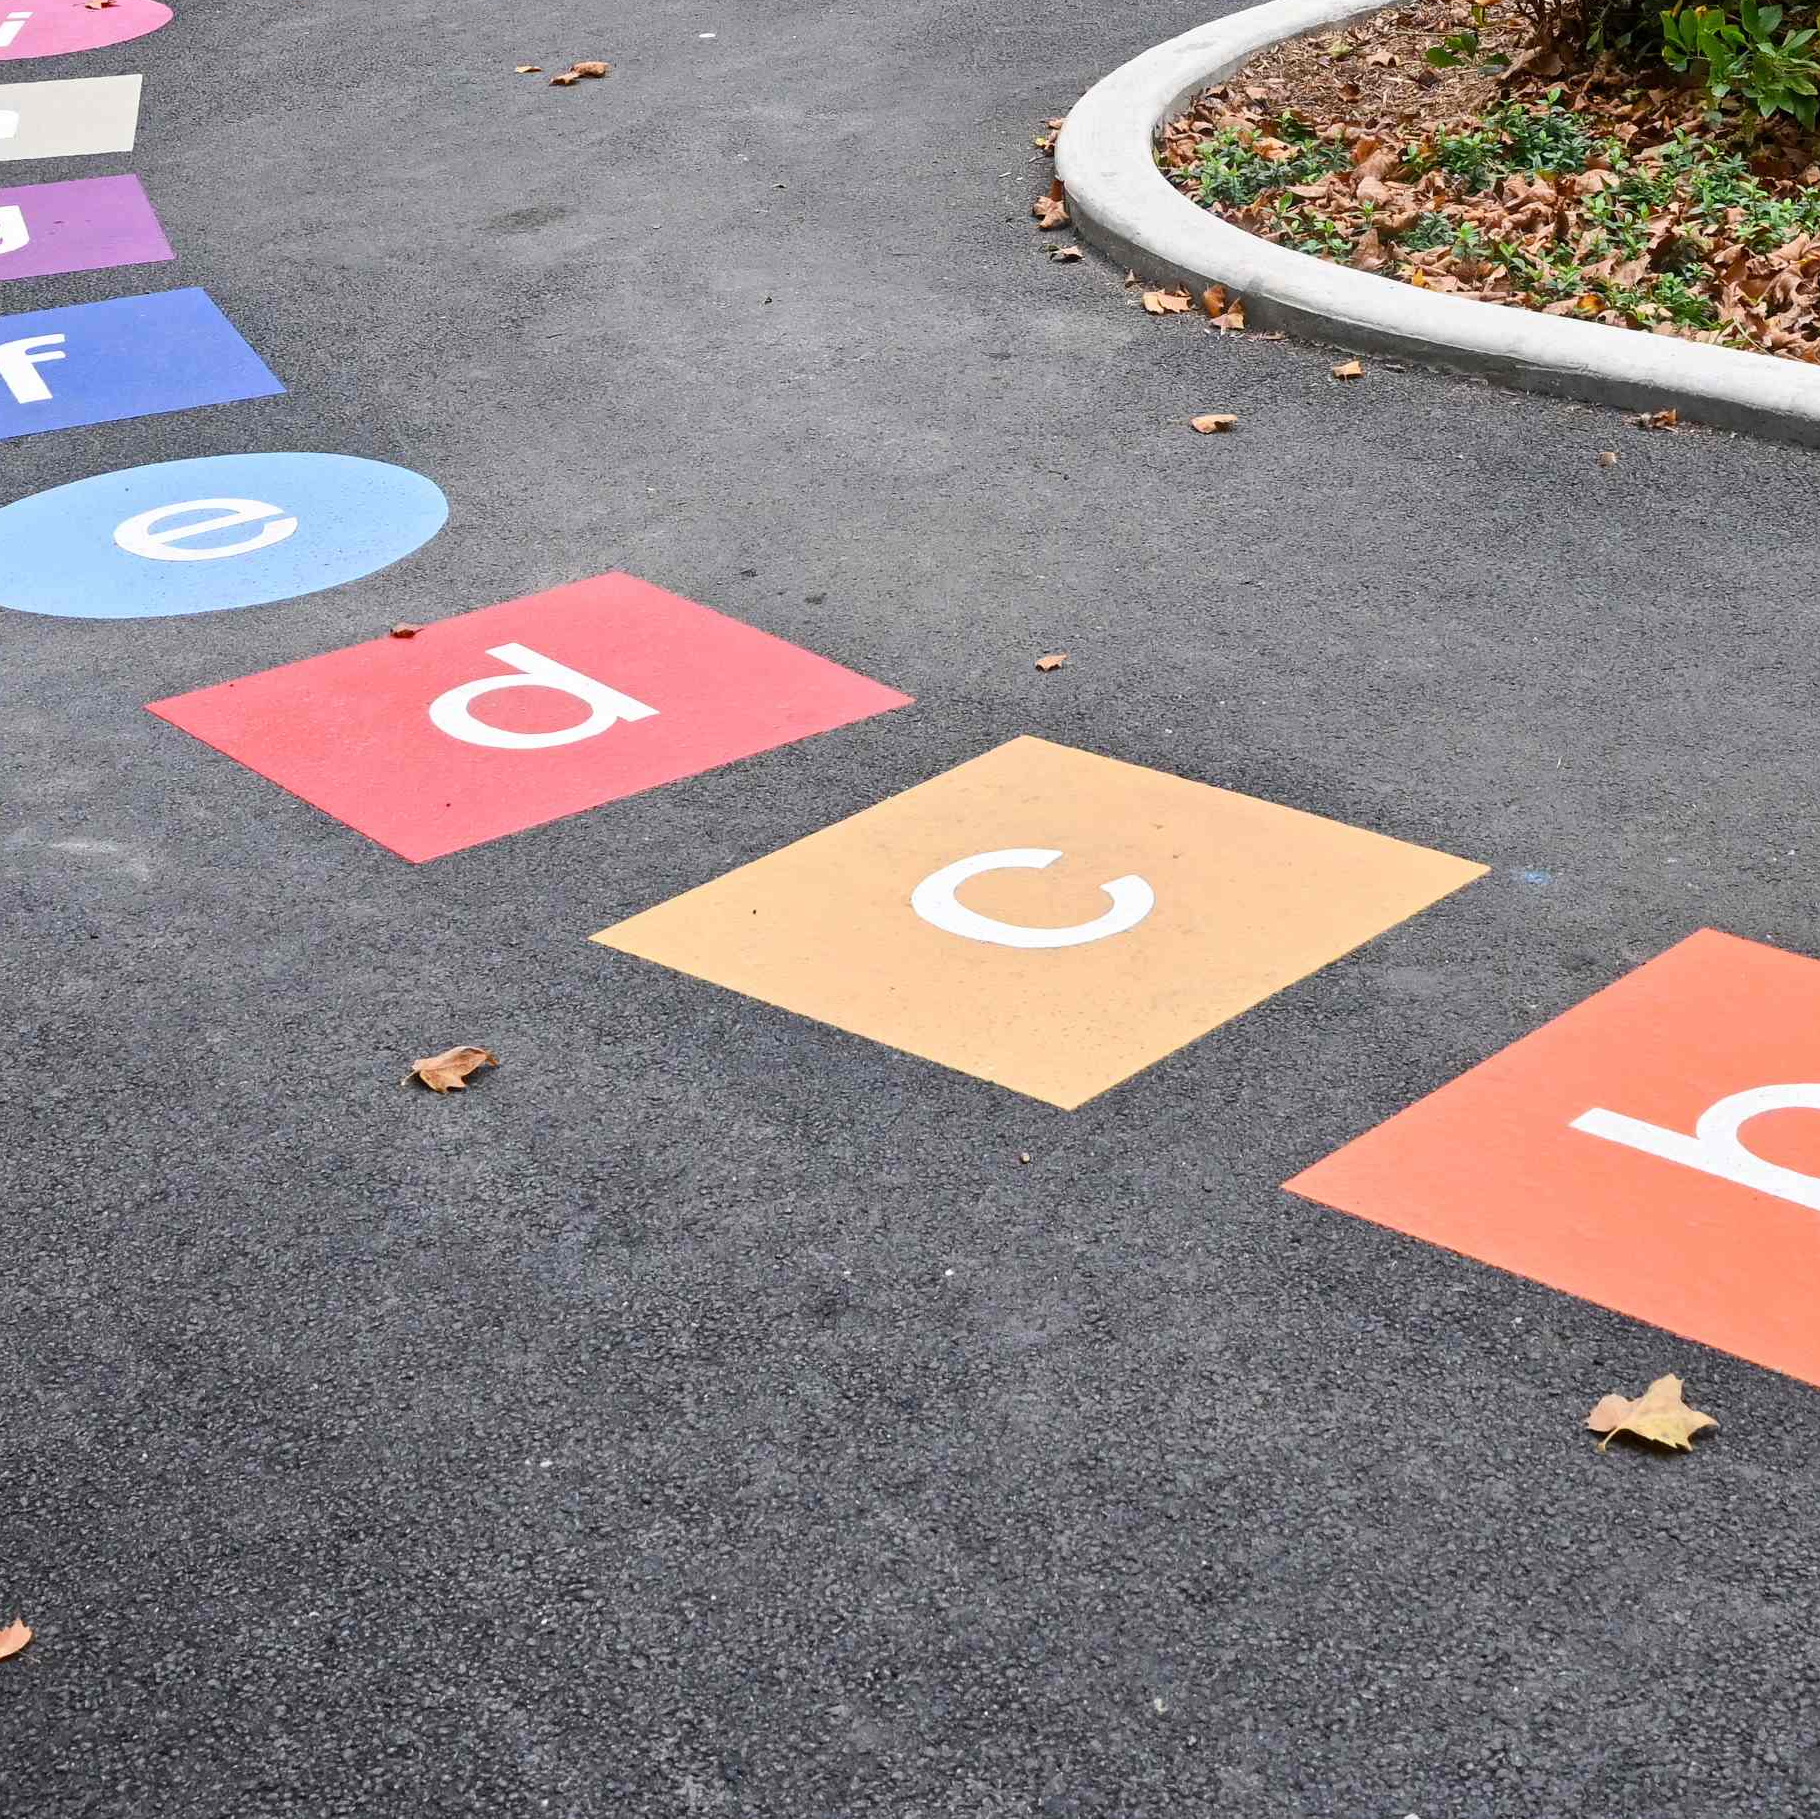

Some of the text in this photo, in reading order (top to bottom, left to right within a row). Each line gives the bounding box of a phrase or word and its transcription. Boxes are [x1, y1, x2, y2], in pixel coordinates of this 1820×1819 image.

[113, 497, 298, 561] e
[427, 641, 661, 750] d
[910, 847, 1156, 950] c
